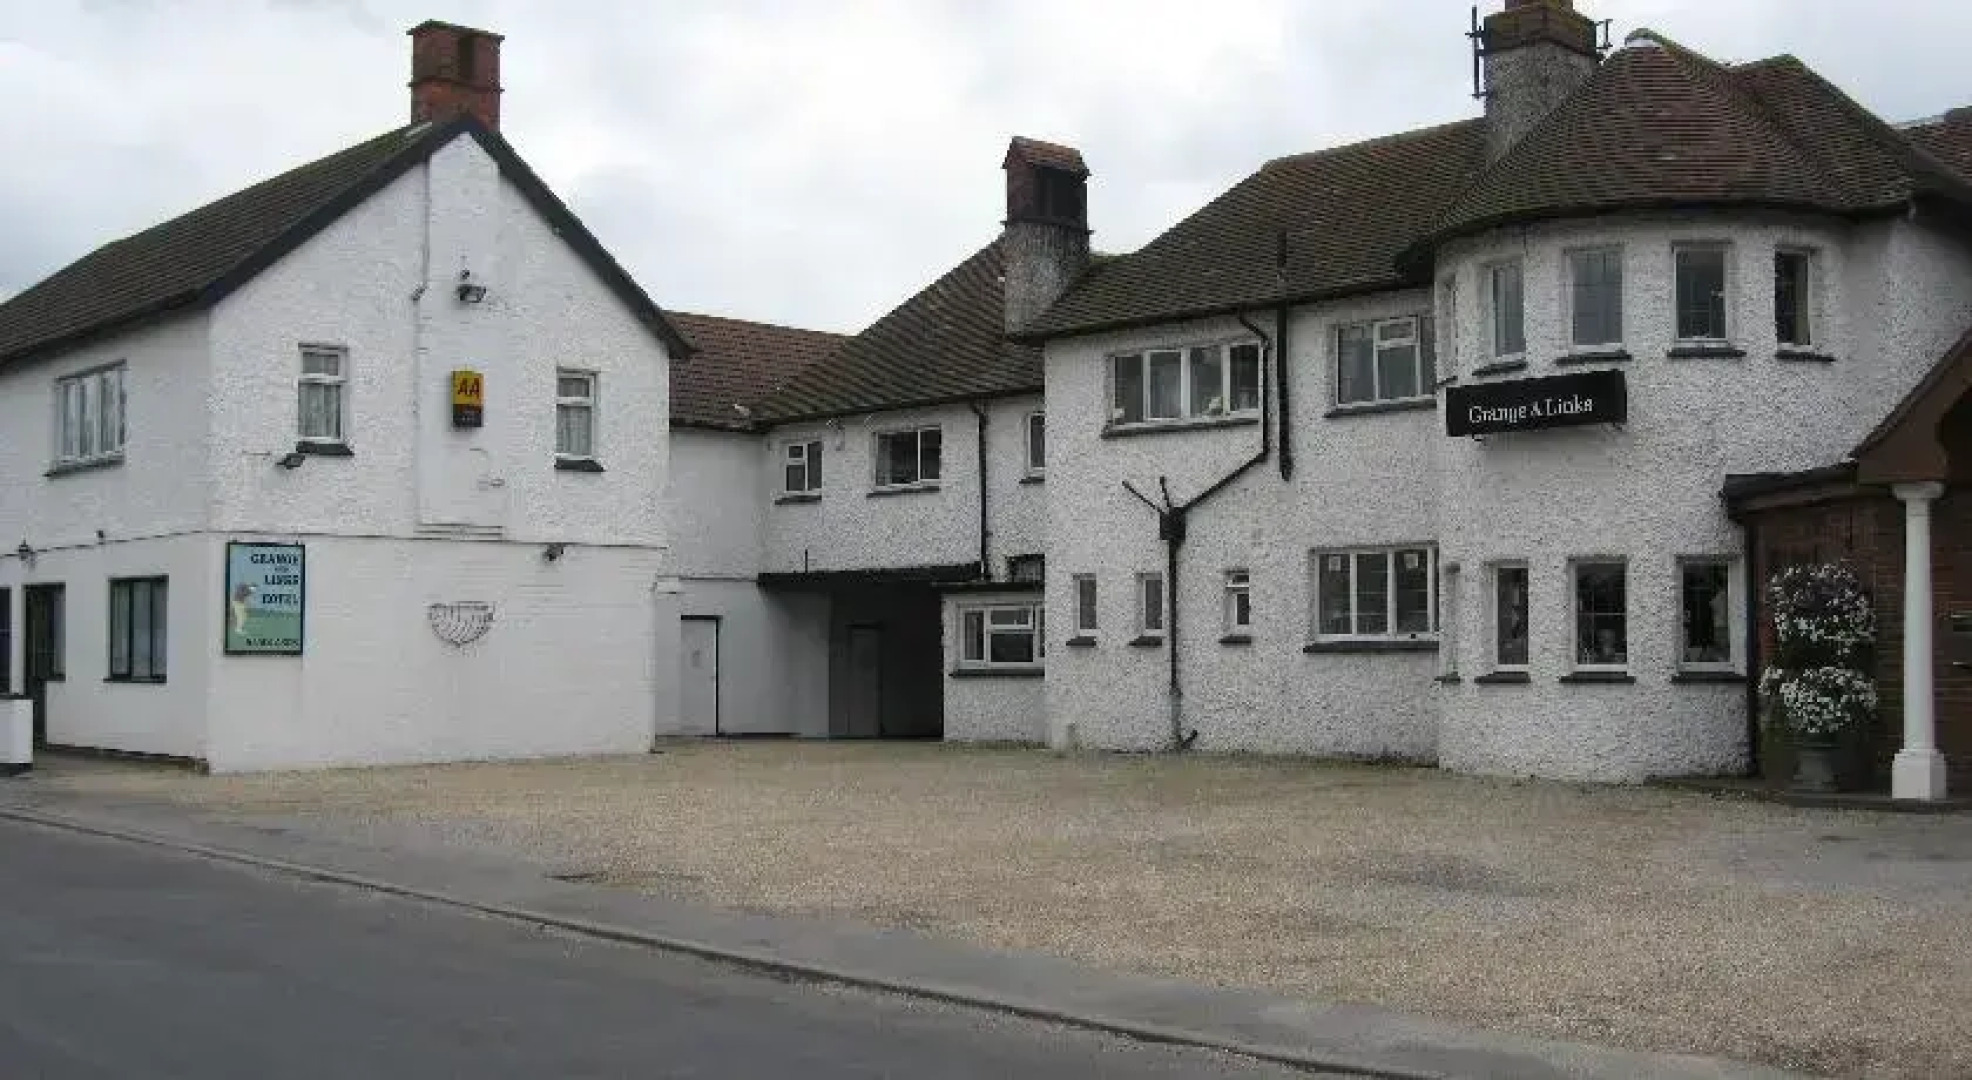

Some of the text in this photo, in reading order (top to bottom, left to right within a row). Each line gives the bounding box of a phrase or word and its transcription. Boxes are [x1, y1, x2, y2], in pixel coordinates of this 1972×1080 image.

[458, 378, 480, 398] AA
[1469, 406, 1526, 424] Grange
[1545, 394, 1593, 416] Links
